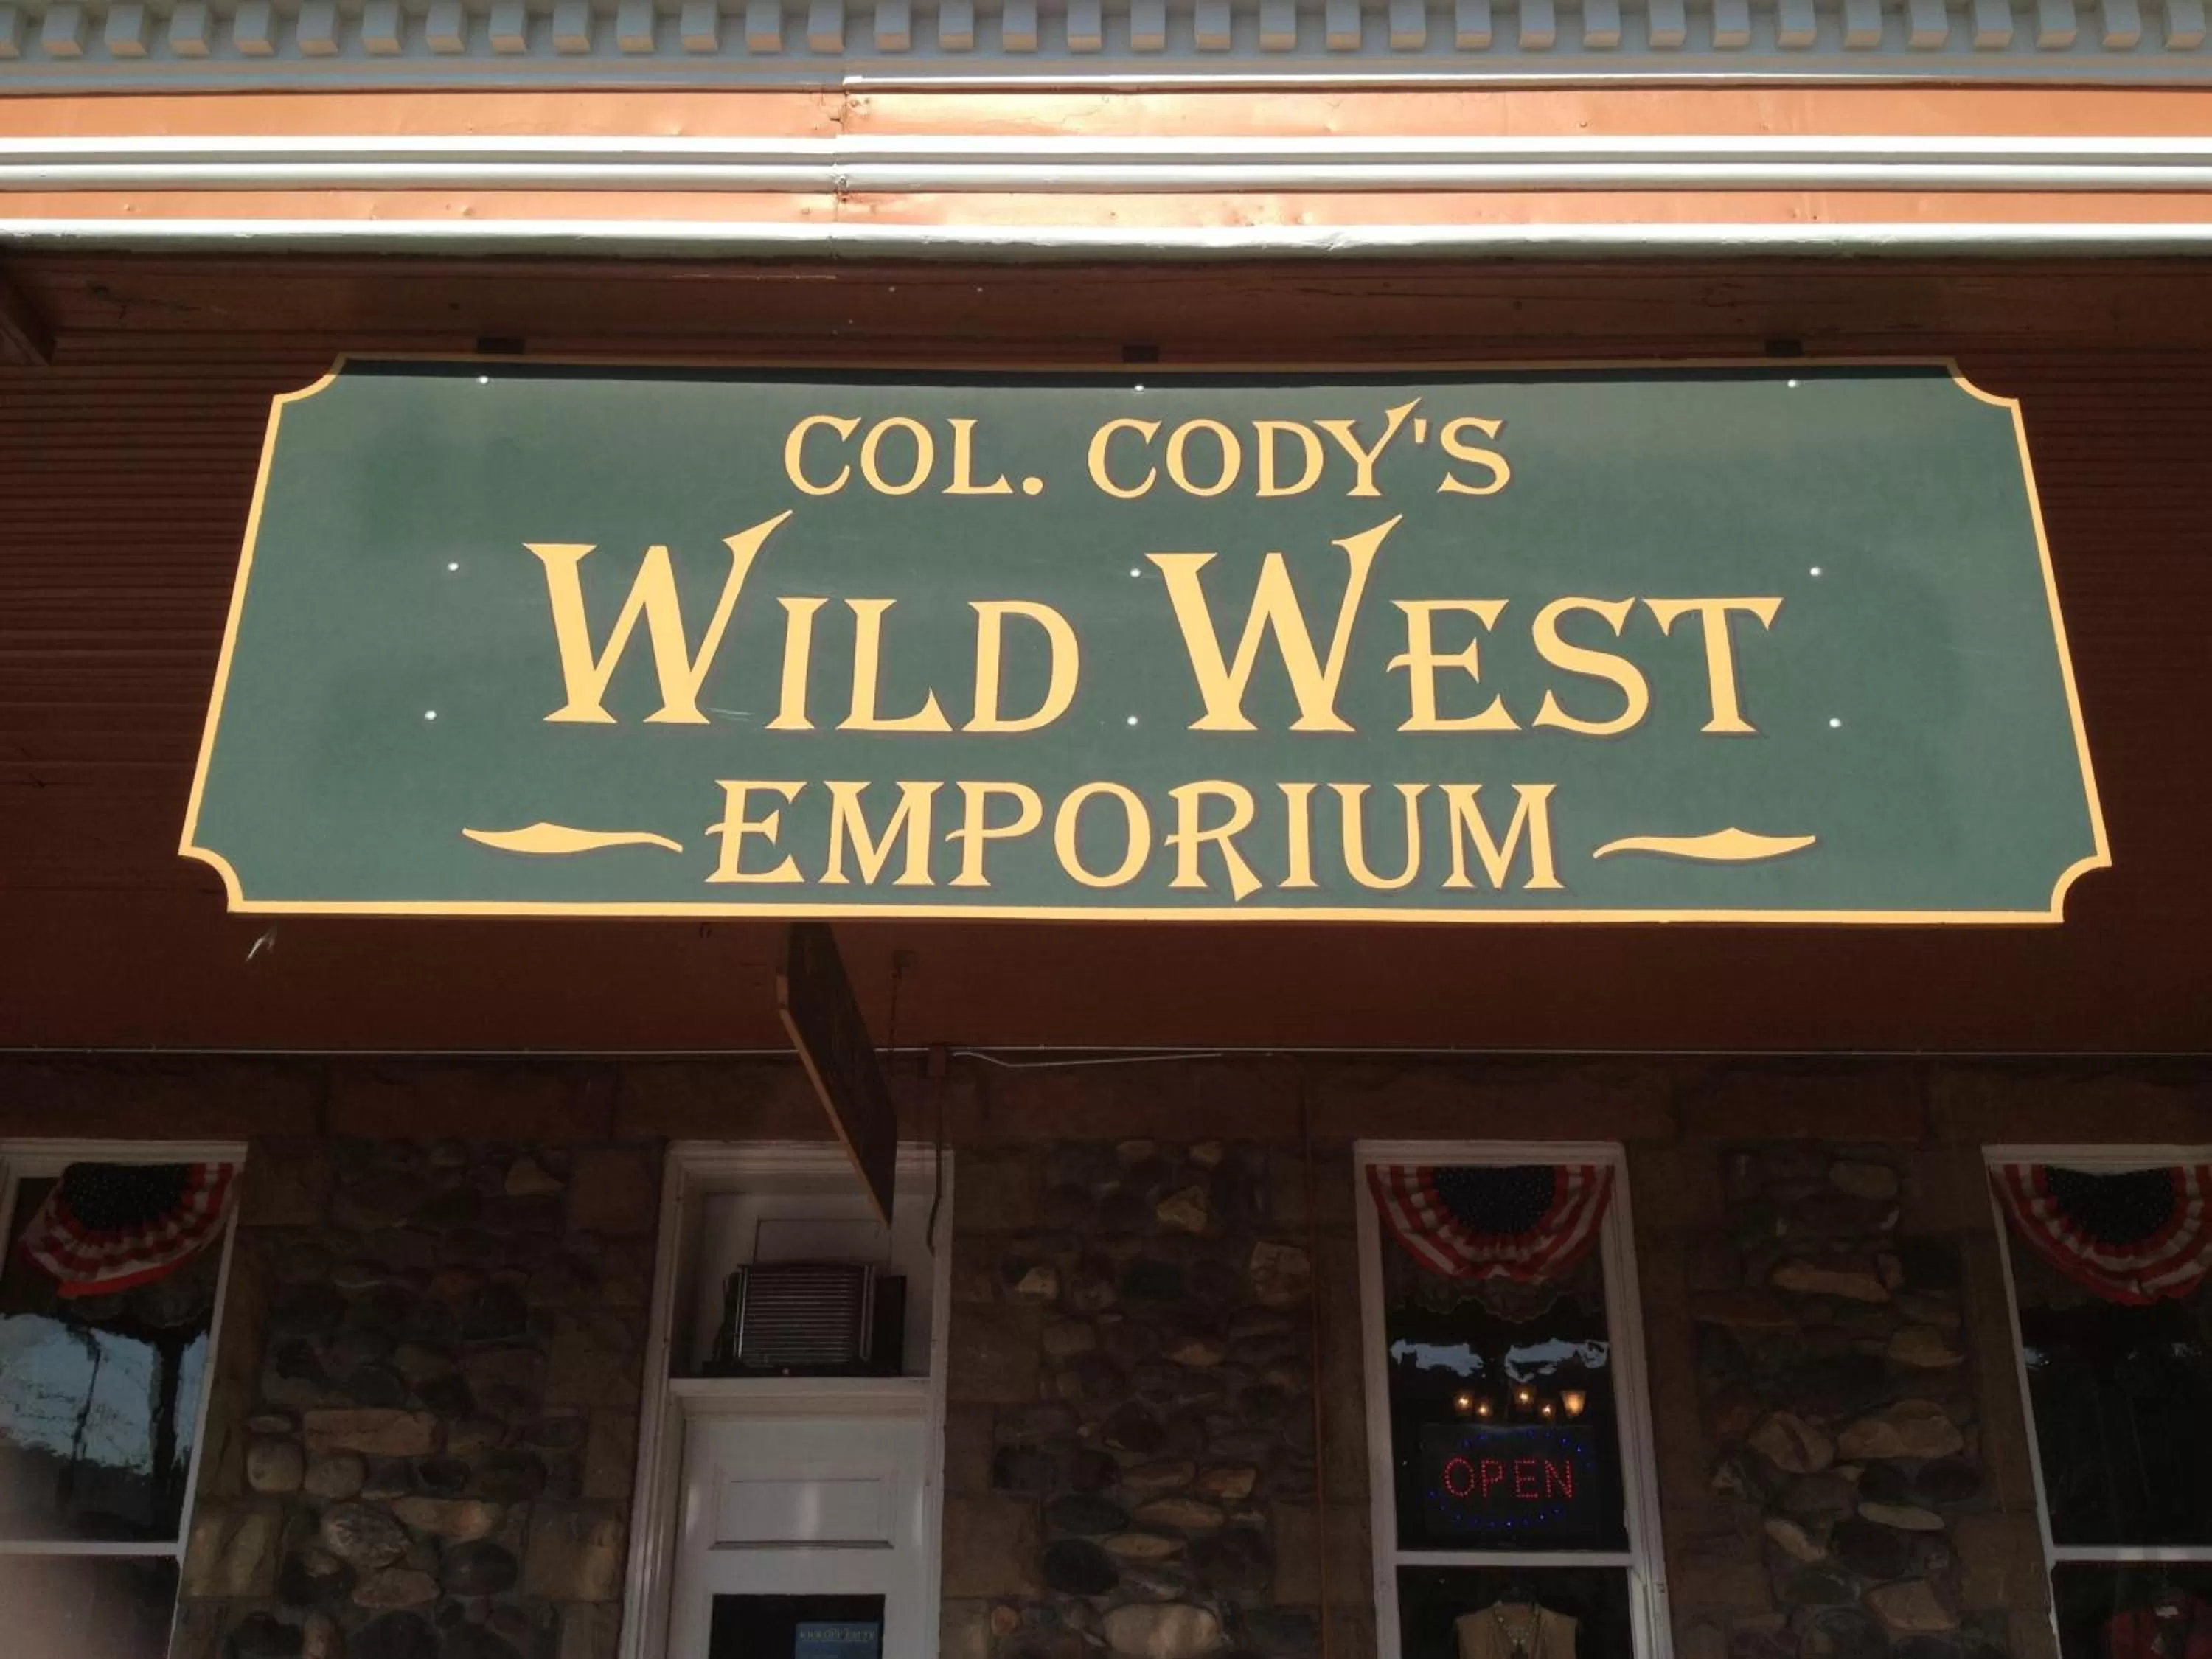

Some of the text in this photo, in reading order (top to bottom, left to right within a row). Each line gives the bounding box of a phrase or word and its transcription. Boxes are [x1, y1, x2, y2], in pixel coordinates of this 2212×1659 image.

[785, 398, 1511, 498] COL. CODY'S
[523, 509, 1783, 735] WILD WEST
[704, 779, 1564, 902] EMPORIUM
[1443, 1458, 1573, 1498] OPEN
